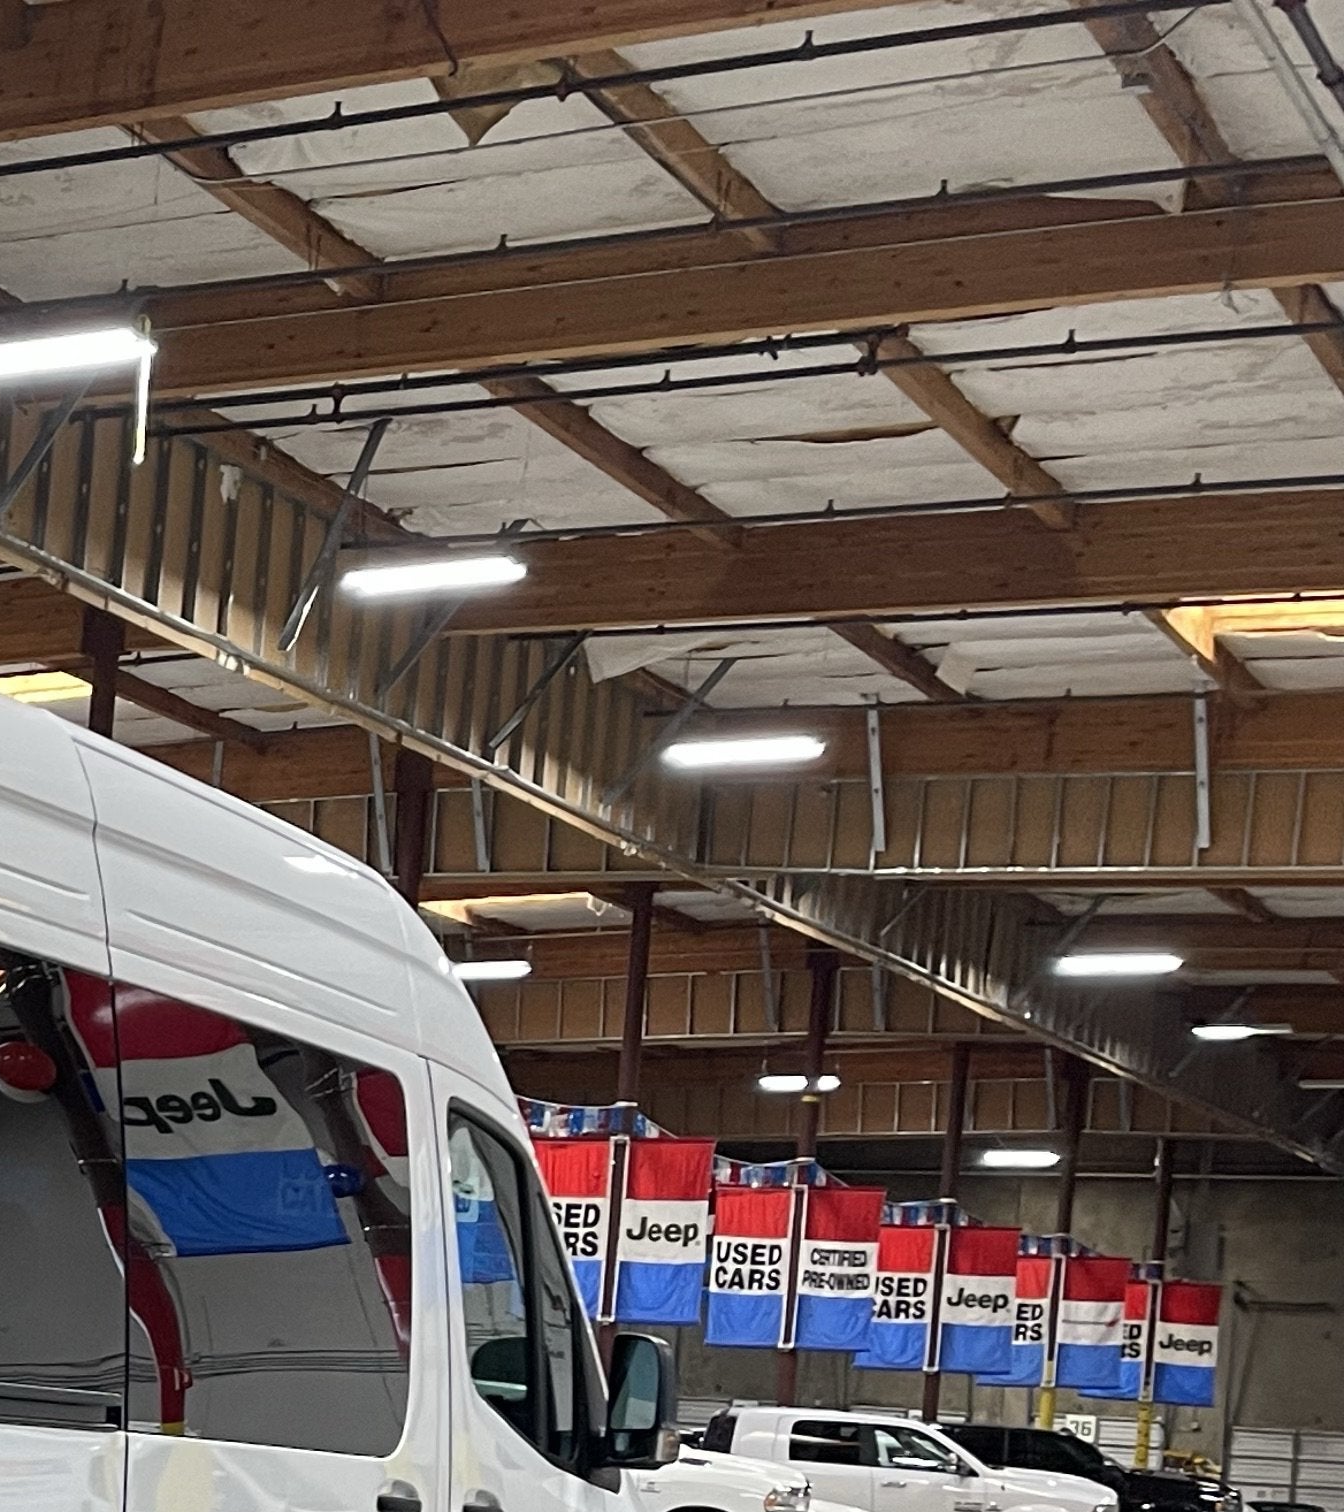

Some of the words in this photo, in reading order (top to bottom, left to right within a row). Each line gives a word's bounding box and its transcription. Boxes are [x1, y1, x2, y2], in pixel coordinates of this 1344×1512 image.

[552, 1203, 600, 1229] SED
[565, 1231, 599, 1256] RS
[626, 1216, 699, 1248] Jeep
[717, 1241, 782, 1266] USED
[811, 1248, 867, 1267] CERTIFIED
[715, 1266, 781, 1291] CARS
[802, 1270, 870, 1291] PRE-OWNED
[876, 1299, 926, 1319] ARS
[947, 1288, 1009, 1313] Jeep
[1016, 1303, 1043, 1321] ED
[1014, 1324, 1042, 1341] RS
[1159, 1334, 1213, 1355] Jeep
